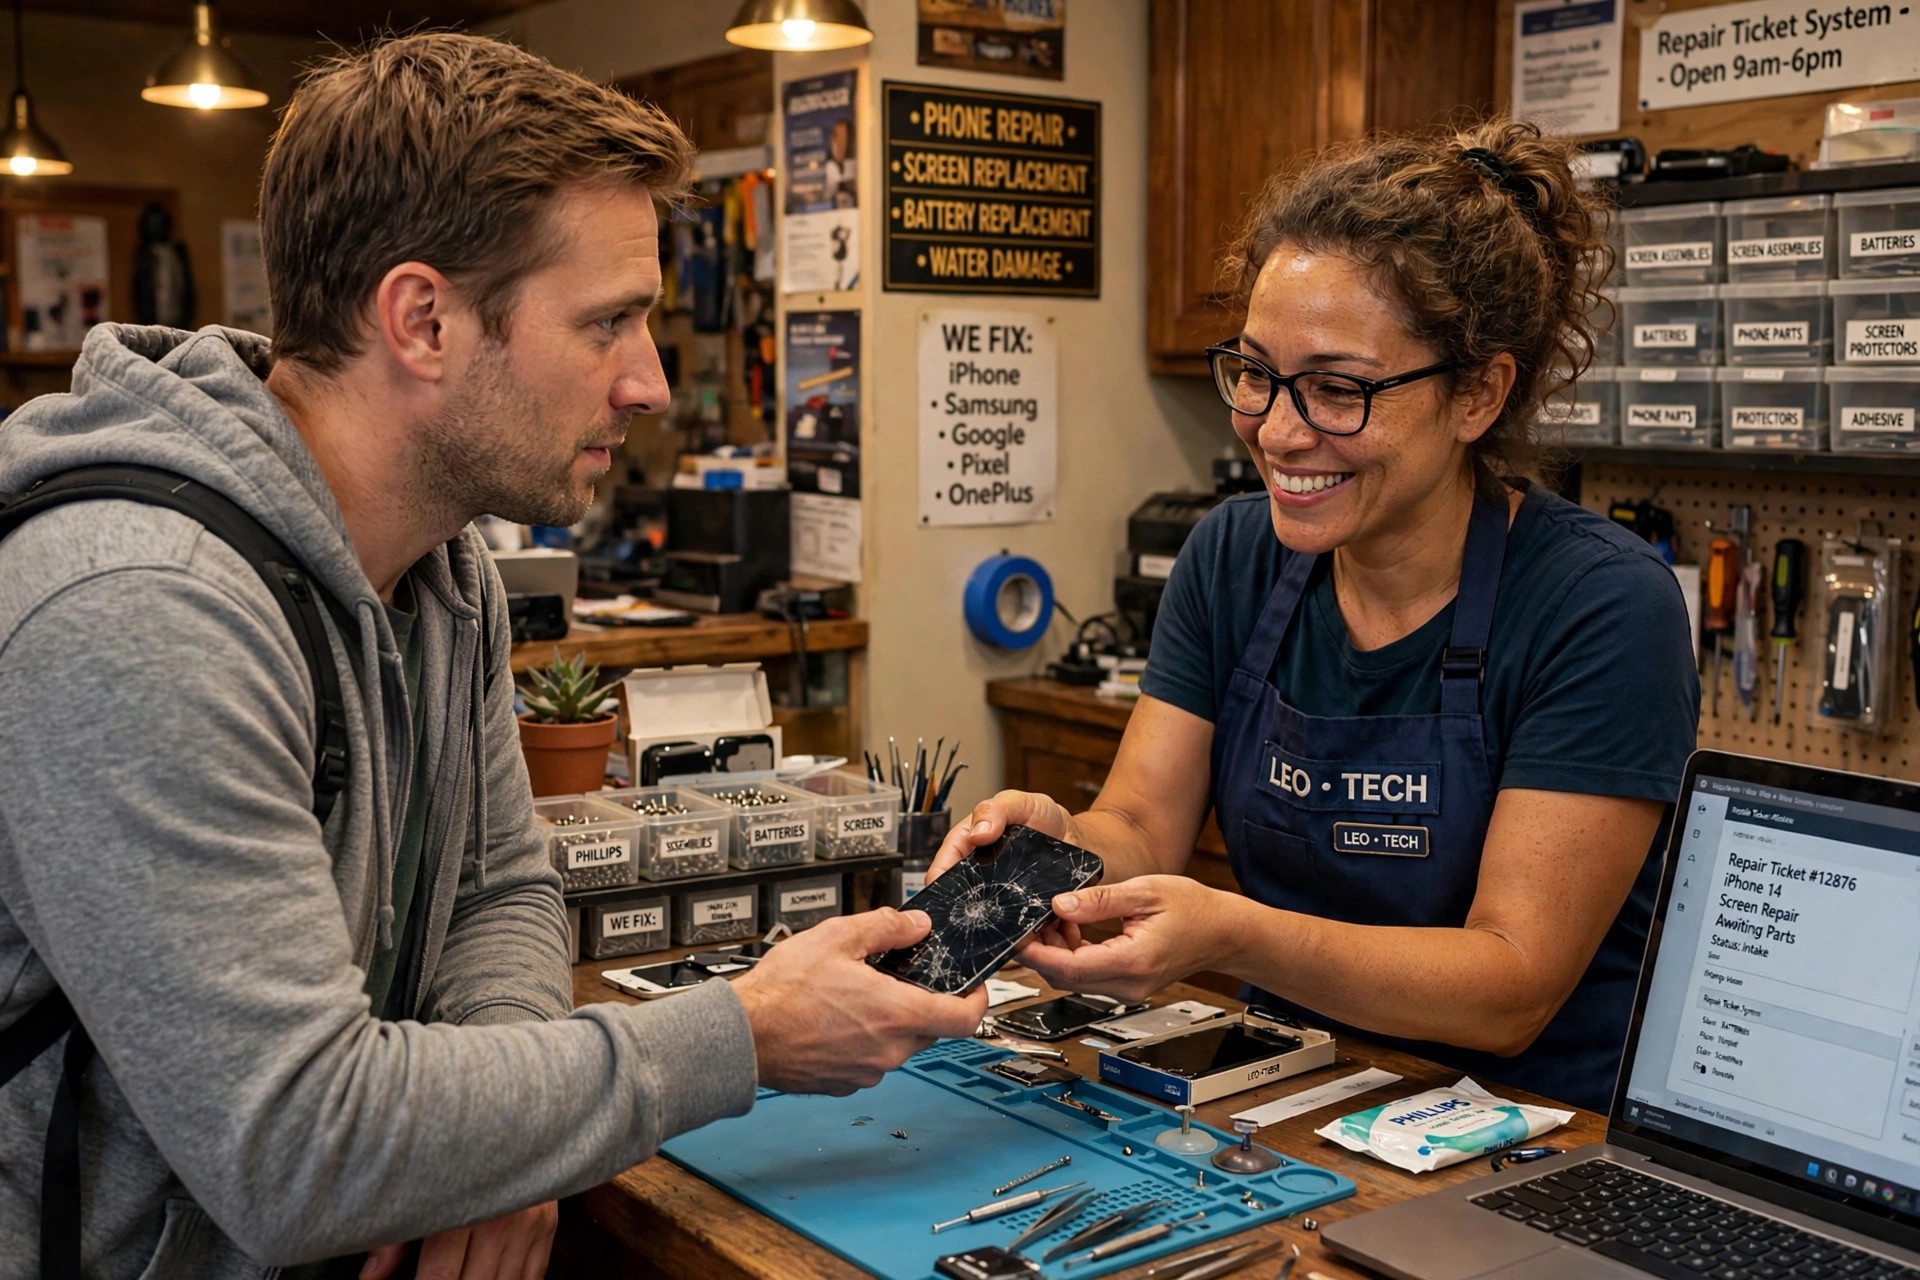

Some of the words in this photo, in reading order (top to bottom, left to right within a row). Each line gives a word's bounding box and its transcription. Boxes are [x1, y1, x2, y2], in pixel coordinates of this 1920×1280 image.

[1657, 24, 1726, 59] Repair
[1731, 15, 1799, 45] Ticket
[1804, 4, 1892, 40] System
[1670, 62, 1727, 91] Open
[1732, 48, 1843, 79] 9am-6pm
[923, 100, 993, 141] PHONE
[996, 108, 1065, 147] REPAIR
[903, 151, 971, 186] SCREEN
[973, 157, 1089, 194] REPLACEMENT
[903, 198, 976, 232] BATTERY
[978, 202, 1092, 238] REPLACEMENT
[1861, 234, 1916, 251] BATTERIES
[929, 246, 990, 279] WATER
[992, 248, 1063, 281] DAMAGE
[942, 324, 982, 353] WE
[989, 325, 1033, 354] FIX:
[1738, 328, 1770, 341] PHONE
[1772, 327, 1803, 341] PARTS
[1865, 325, 1905, 339] SCREEN
[1850, 341, 1918, 356] PROTECTORS
[949, 361, 1021, 386] iPhone
[944, 392, 1038, 422] Samsung
[1851, 412, 1905, 427] ADHESIVE
[951, 422, 1026, 451] Google
[961, 451, 1010, 476] Pixel
[948, 481, 1034, 506] OnePlus
[1269, 756, 1312, 798] LEO
[1341, 772, 1428, 804] TECH
[754, 824, 806, 842] BATTERIES
[843, 816, 886, 832] SCREENS
[1343, 831, 1371, 846] LEO
[1382, 833, 1419, 850] TECH
[575, 845, 623, 863] PHILLIPS
[1728, 852, 1768, 873] Repair
[1770, 861, 1807, 882] Ticket
[1808, 869, 1858, 892] #12876
[1723, 872, 1764, 895] iPhone
[1768, 882, 1783, 898] 14
[610, 915, 630, 930] WE
[632, 911, 656, 929] FIX:
[1719, 893, 1758, 914] Screen
[1760, 902, 1800, 923] Repair
[1765, 924, 1797, 945] Parts
[1388, 1098, 1472, 1126] PHILLIPS
